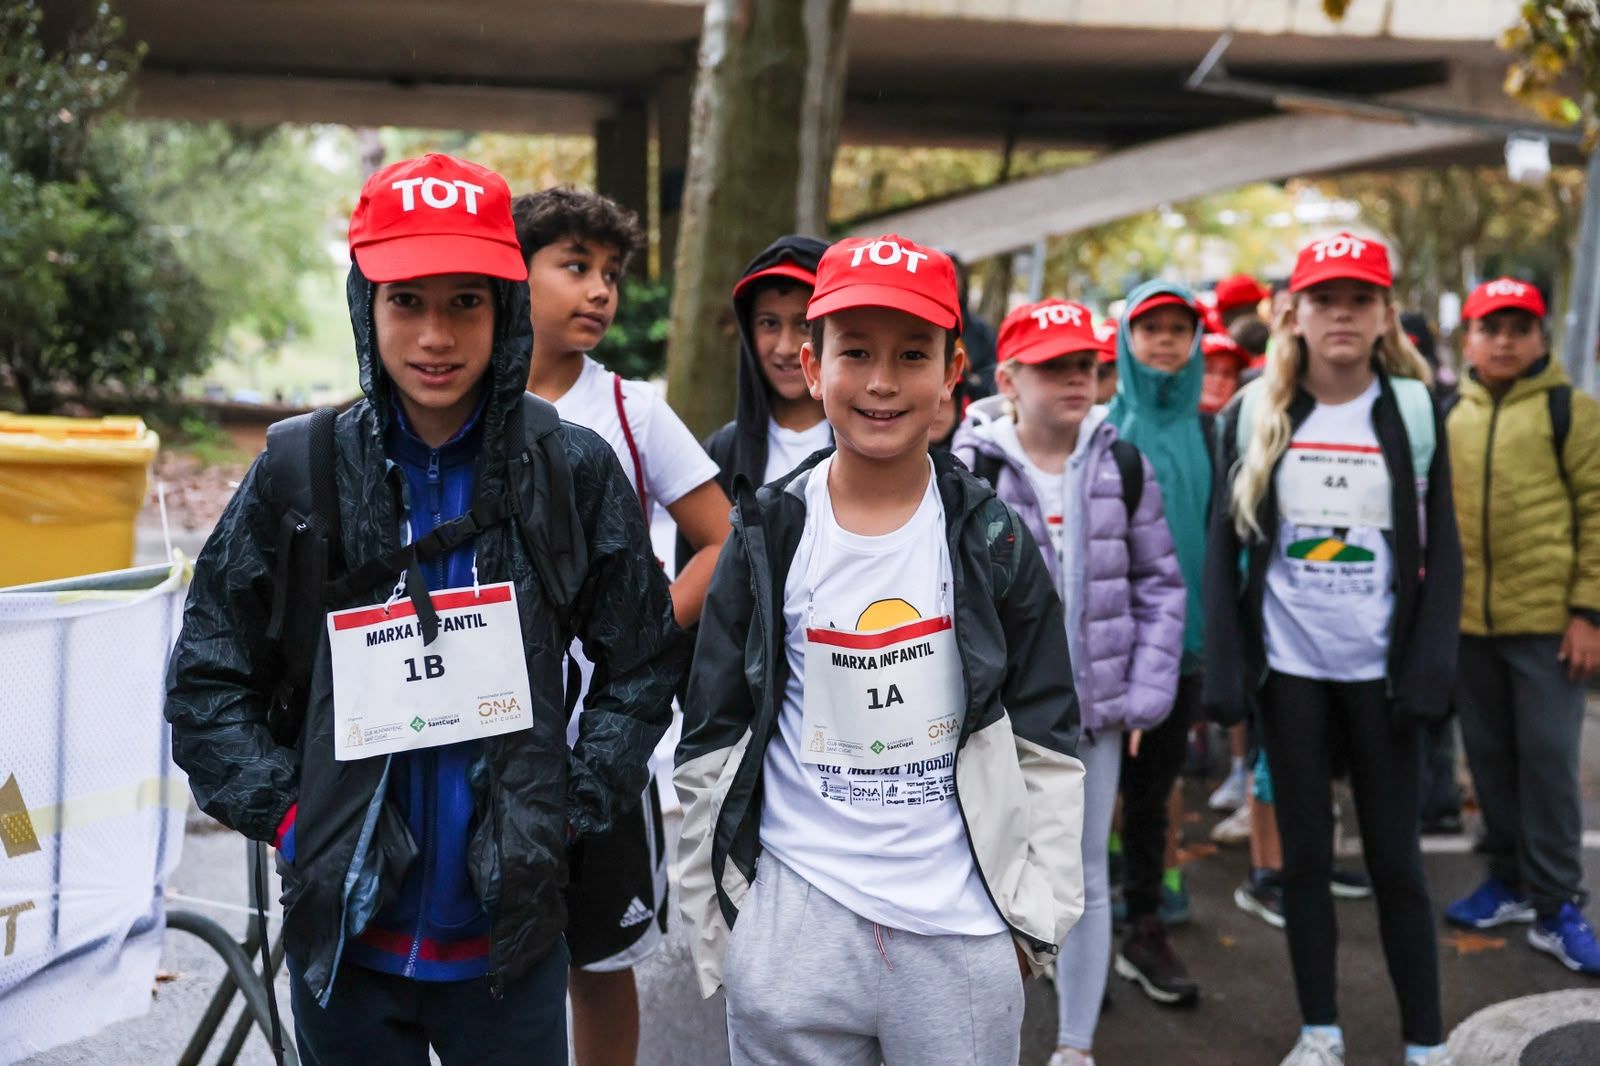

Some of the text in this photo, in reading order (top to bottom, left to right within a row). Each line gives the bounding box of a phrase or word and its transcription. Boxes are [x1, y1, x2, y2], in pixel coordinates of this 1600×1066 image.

[391, 176, 485, 215] TOT
[847, 240, 928, 274] TOT
[1312, 237, 1367, 263] TOT
[1030, 304, 1083, 330] TOT
[366, 613, 488, 647] MARXA IANTIL
[404, 654, 446, 683] 1B
[831, 641, 935, 670] MARXA INFANTIL
[478, 697, 521, 717] ONA
[866, 683, 905, 710] 1A
[928, 718, 960, 739] ONA
[852, 787, 881, 798] ONA
